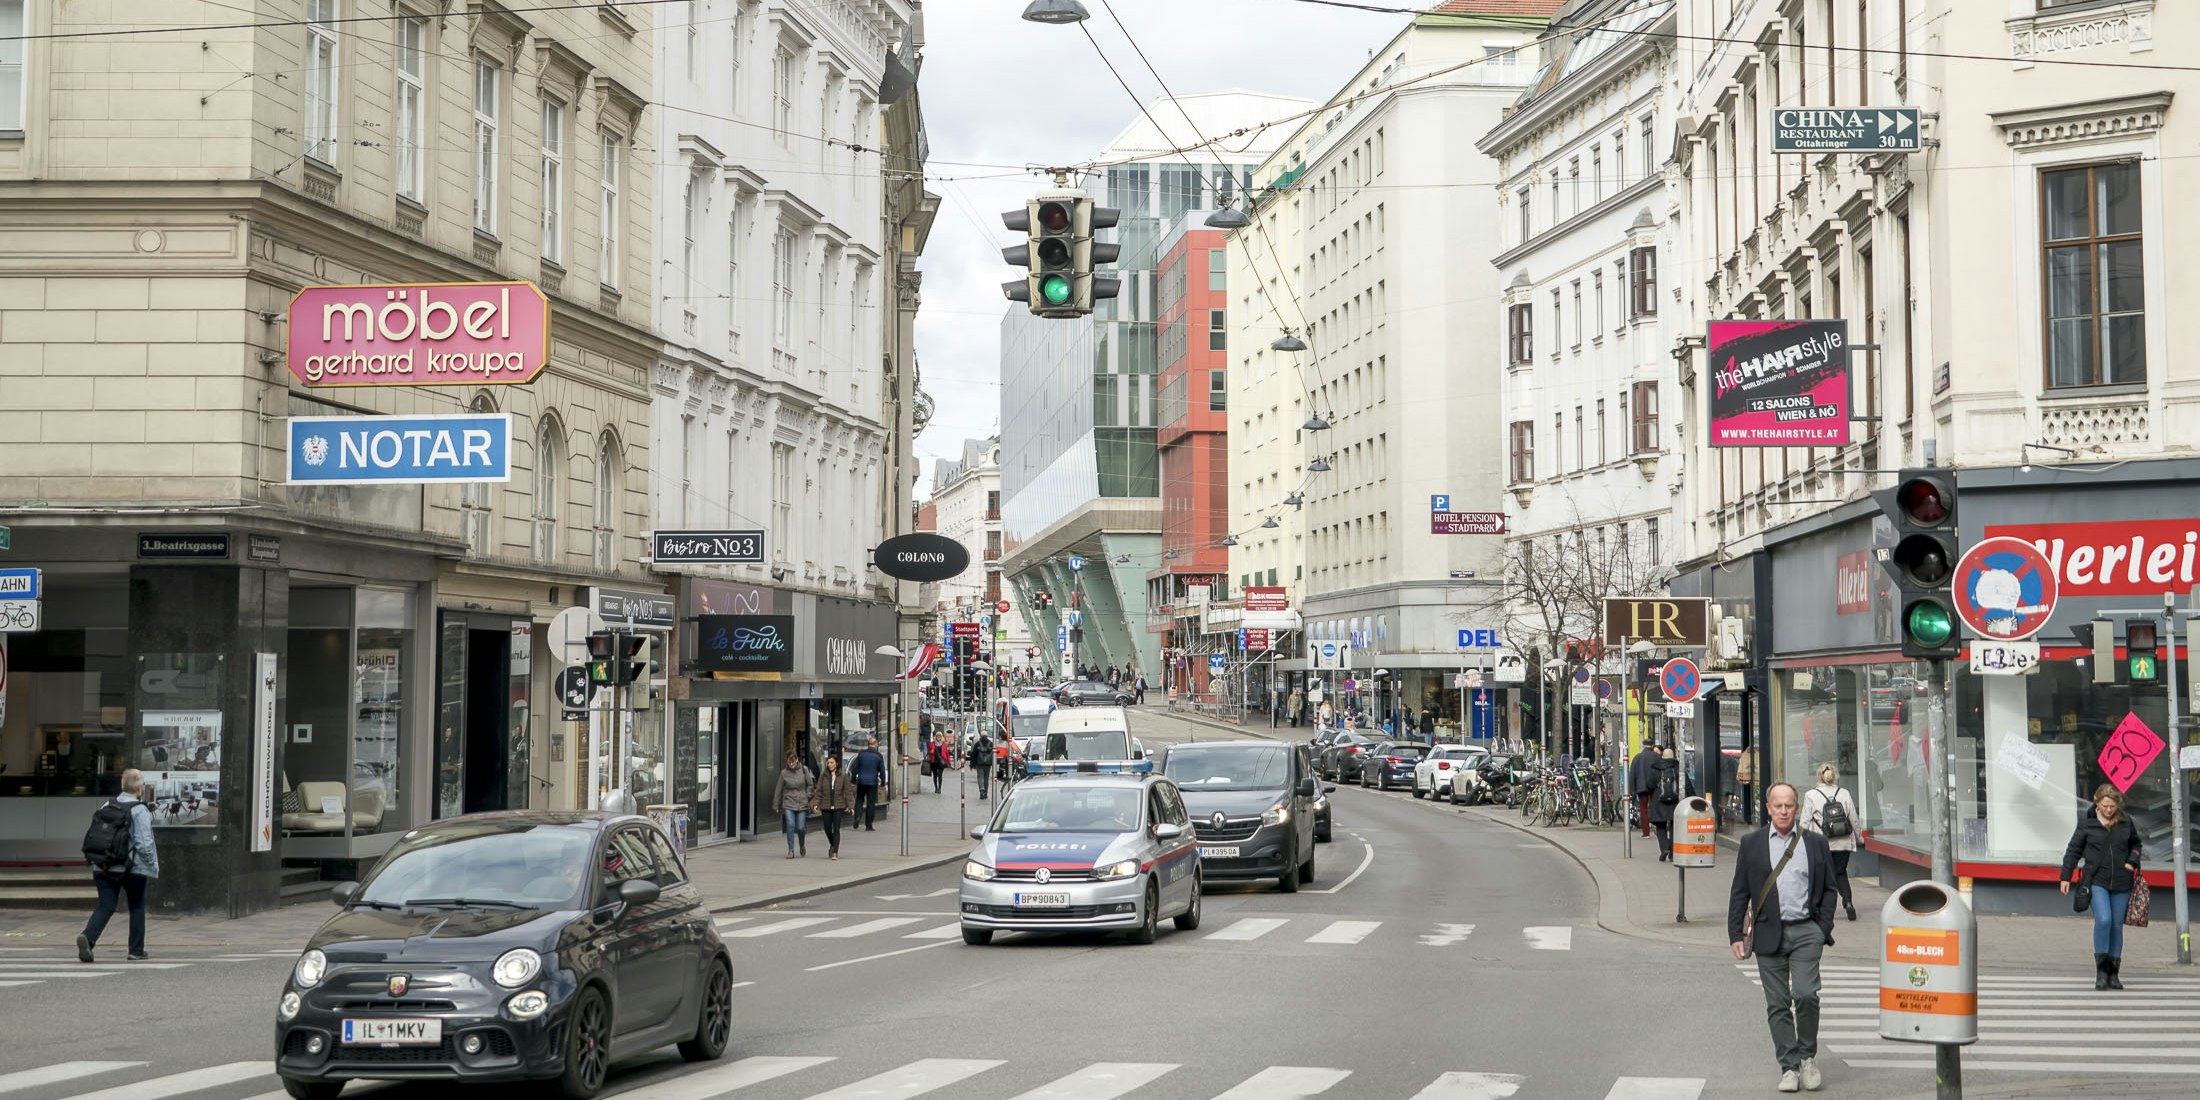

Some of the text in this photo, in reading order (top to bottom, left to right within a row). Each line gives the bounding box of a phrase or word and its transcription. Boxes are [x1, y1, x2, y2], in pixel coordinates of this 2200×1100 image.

[1779, 111, 1873, 128] CHINA-
[1780, 129, 1864, 139] RESTAURANT
[1795, 140, 1849, 149] Ottakringer
[1879, 135, 1914, 148] 30 m
[323, 288, 510, 341] möbel
[305, 348, 524, 381] gerhard kroupa
[1742, 371, 1787, 391] WORLDCHAMPION
[1751, 396, 1811, 410] 12 SALONS
[1778, 405, 1836, 420] WIEN & NÖ
[1720, 429, 1839, 438] WWW.THEHAIRSTYLE.AT
[339, 429, 493, 469] NOTAR
[1436, 497, 1445, 508] P
[1434, 513, 1495, 523] HOTEL PENSION
[1448, 523, 1496, 533] STADTPARK
[154, 541, 225, 551] Beatrixgasse
[663, 538, 713, 556] Bistro
[897, 551, 945, 563] COLONO
[1838, 560, 1868, 605] Allerlei
[1628, 601, 1686, 639] HR
[827, 637, 866, 674] COLONO
[1021, 895, 1065, 904] BP 90843
[363, 1023, 375, 1038] IL
[388, 1023, 426, 1038] 1MKV
